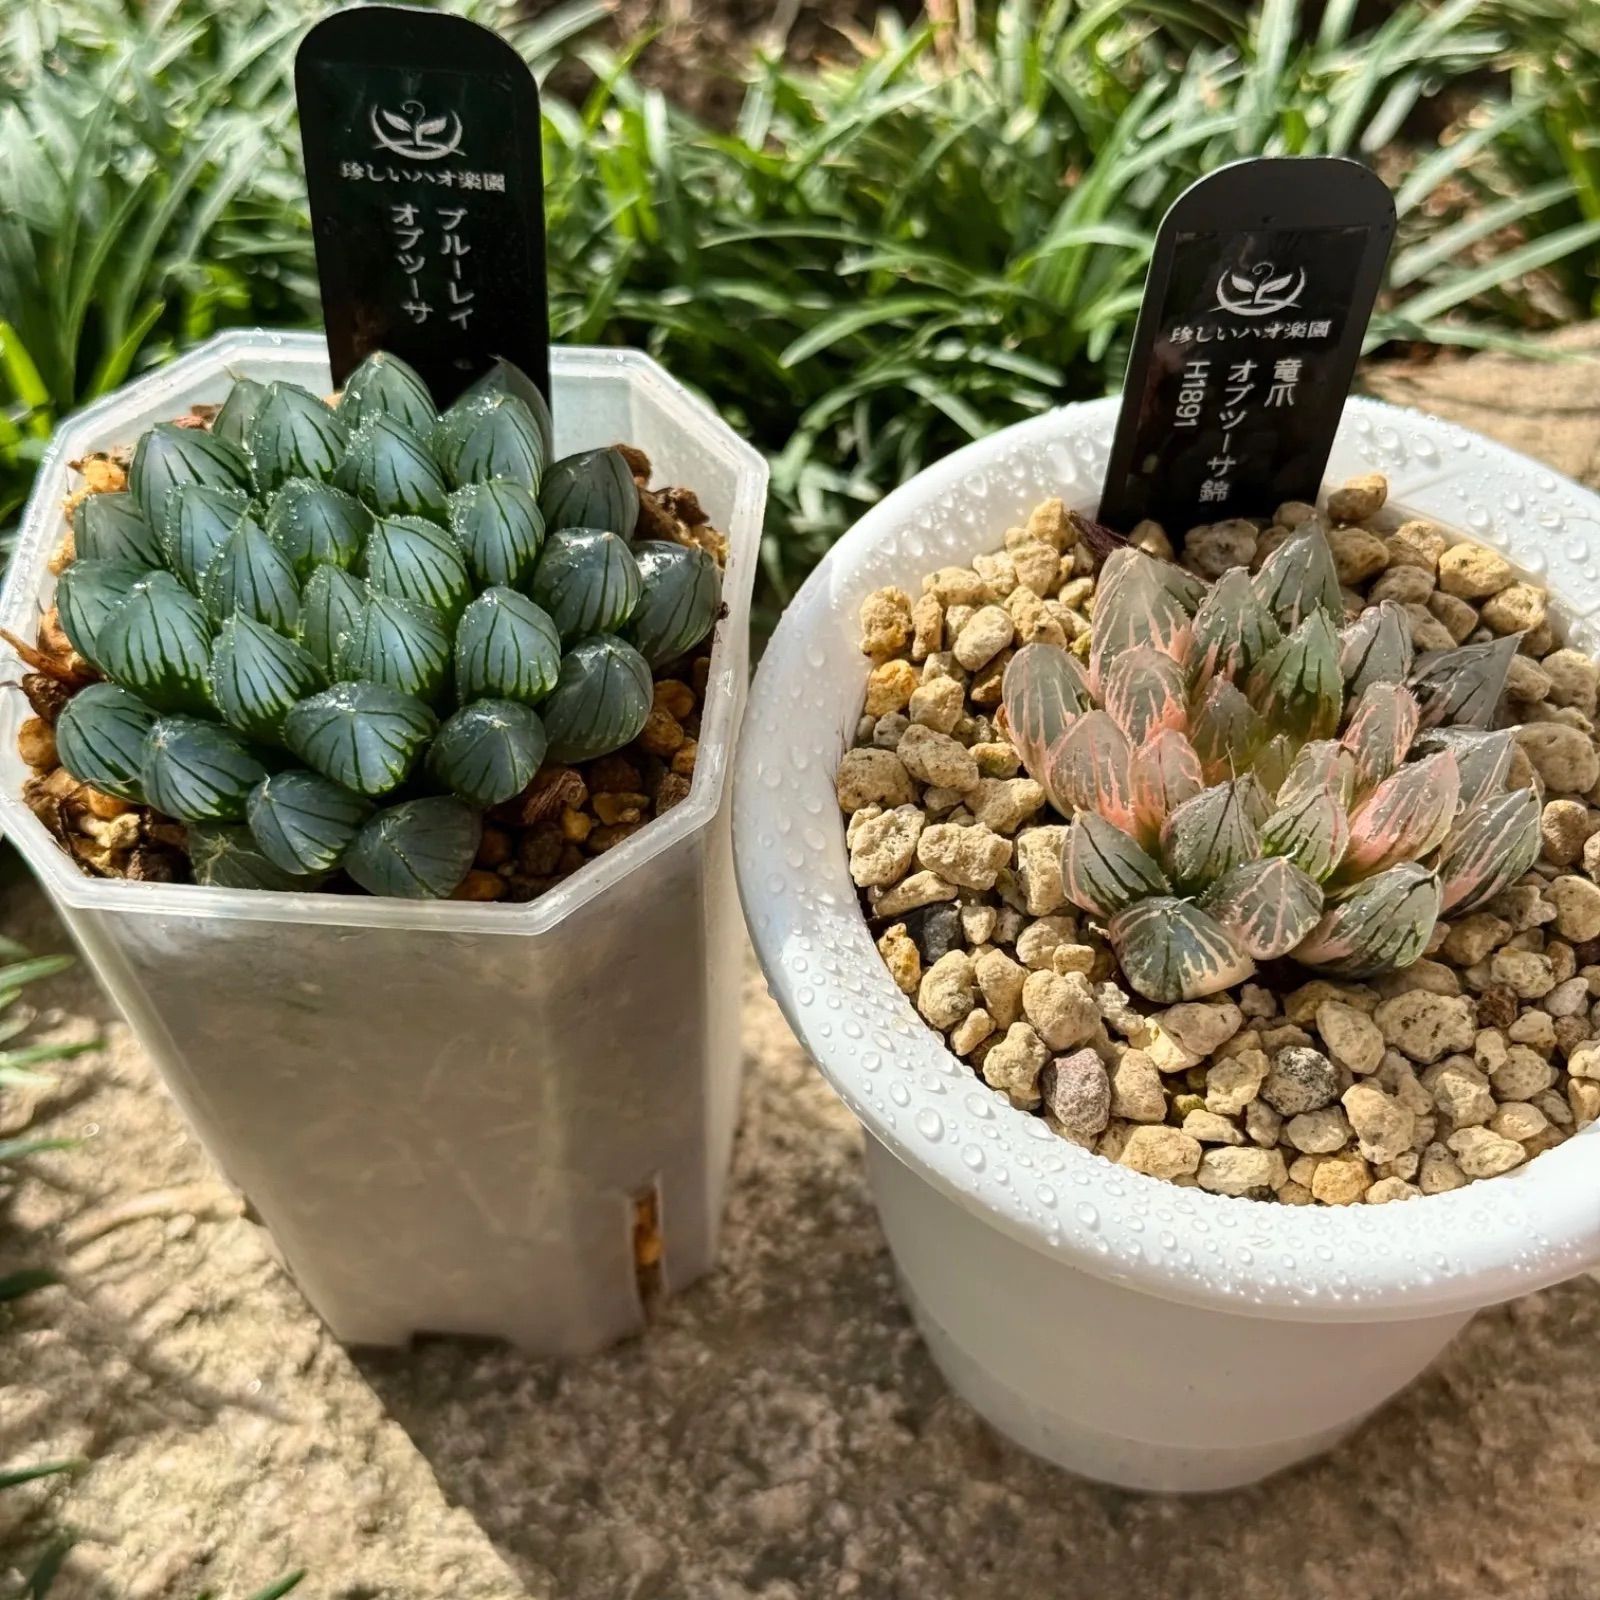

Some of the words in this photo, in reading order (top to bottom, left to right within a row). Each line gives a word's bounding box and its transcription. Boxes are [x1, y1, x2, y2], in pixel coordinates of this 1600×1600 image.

[340, 161, 506, 192] 珍しいハオ楽園
[1169, 320, 1332, 344] 珍しいハオ楽園
[1173, 361, 1211, 427] H1891
[1264, 358, 1303, 407] 竜爪
